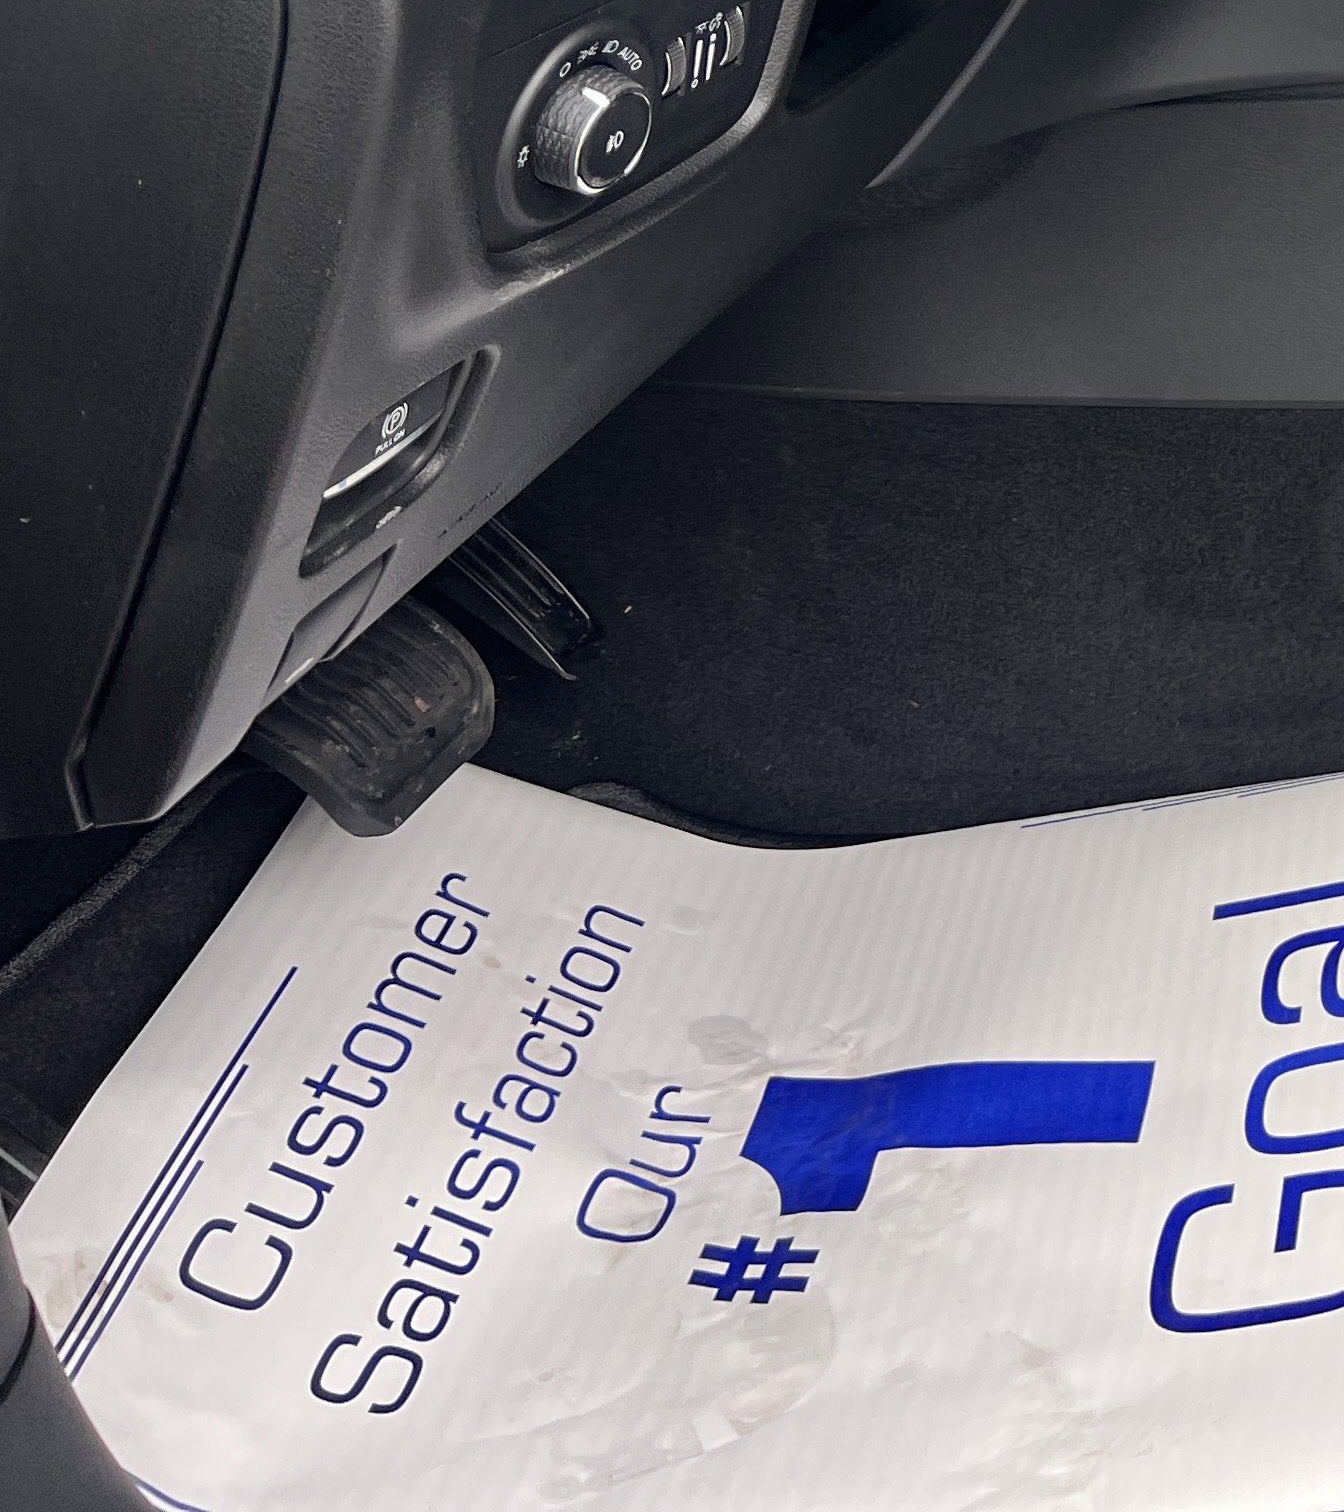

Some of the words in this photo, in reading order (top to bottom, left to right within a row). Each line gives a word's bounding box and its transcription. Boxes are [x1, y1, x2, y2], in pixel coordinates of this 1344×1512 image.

[617, 46, 643, 72] AUTO
[180, 871, 493, 1312] Customer
[310, 904, 648, 1414] Satisfaction
[577, 1084, 712, 1243] Our
